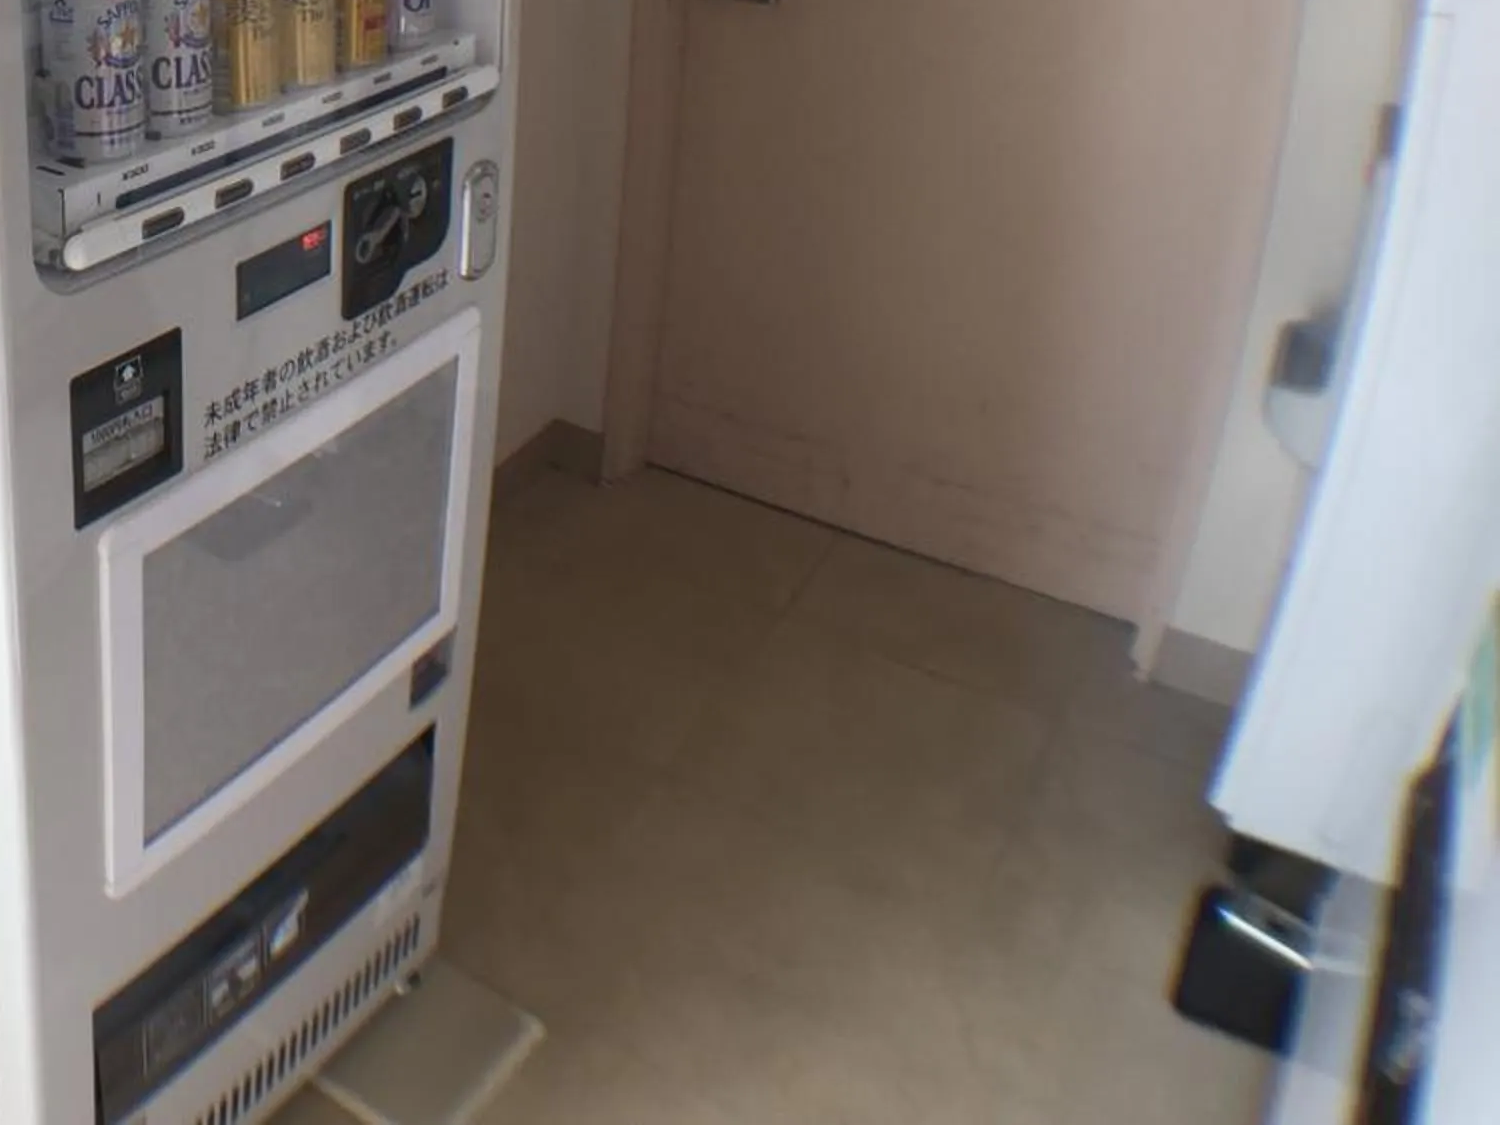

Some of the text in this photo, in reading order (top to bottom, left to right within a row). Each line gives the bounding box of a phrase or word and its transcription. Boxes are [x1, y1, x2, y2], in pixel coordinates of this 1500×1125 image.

[203, 268, 449, 429] 未成年者の飲酒および飲酒運転は
[203, 330, 398, 461] 法律で禁止されています。
